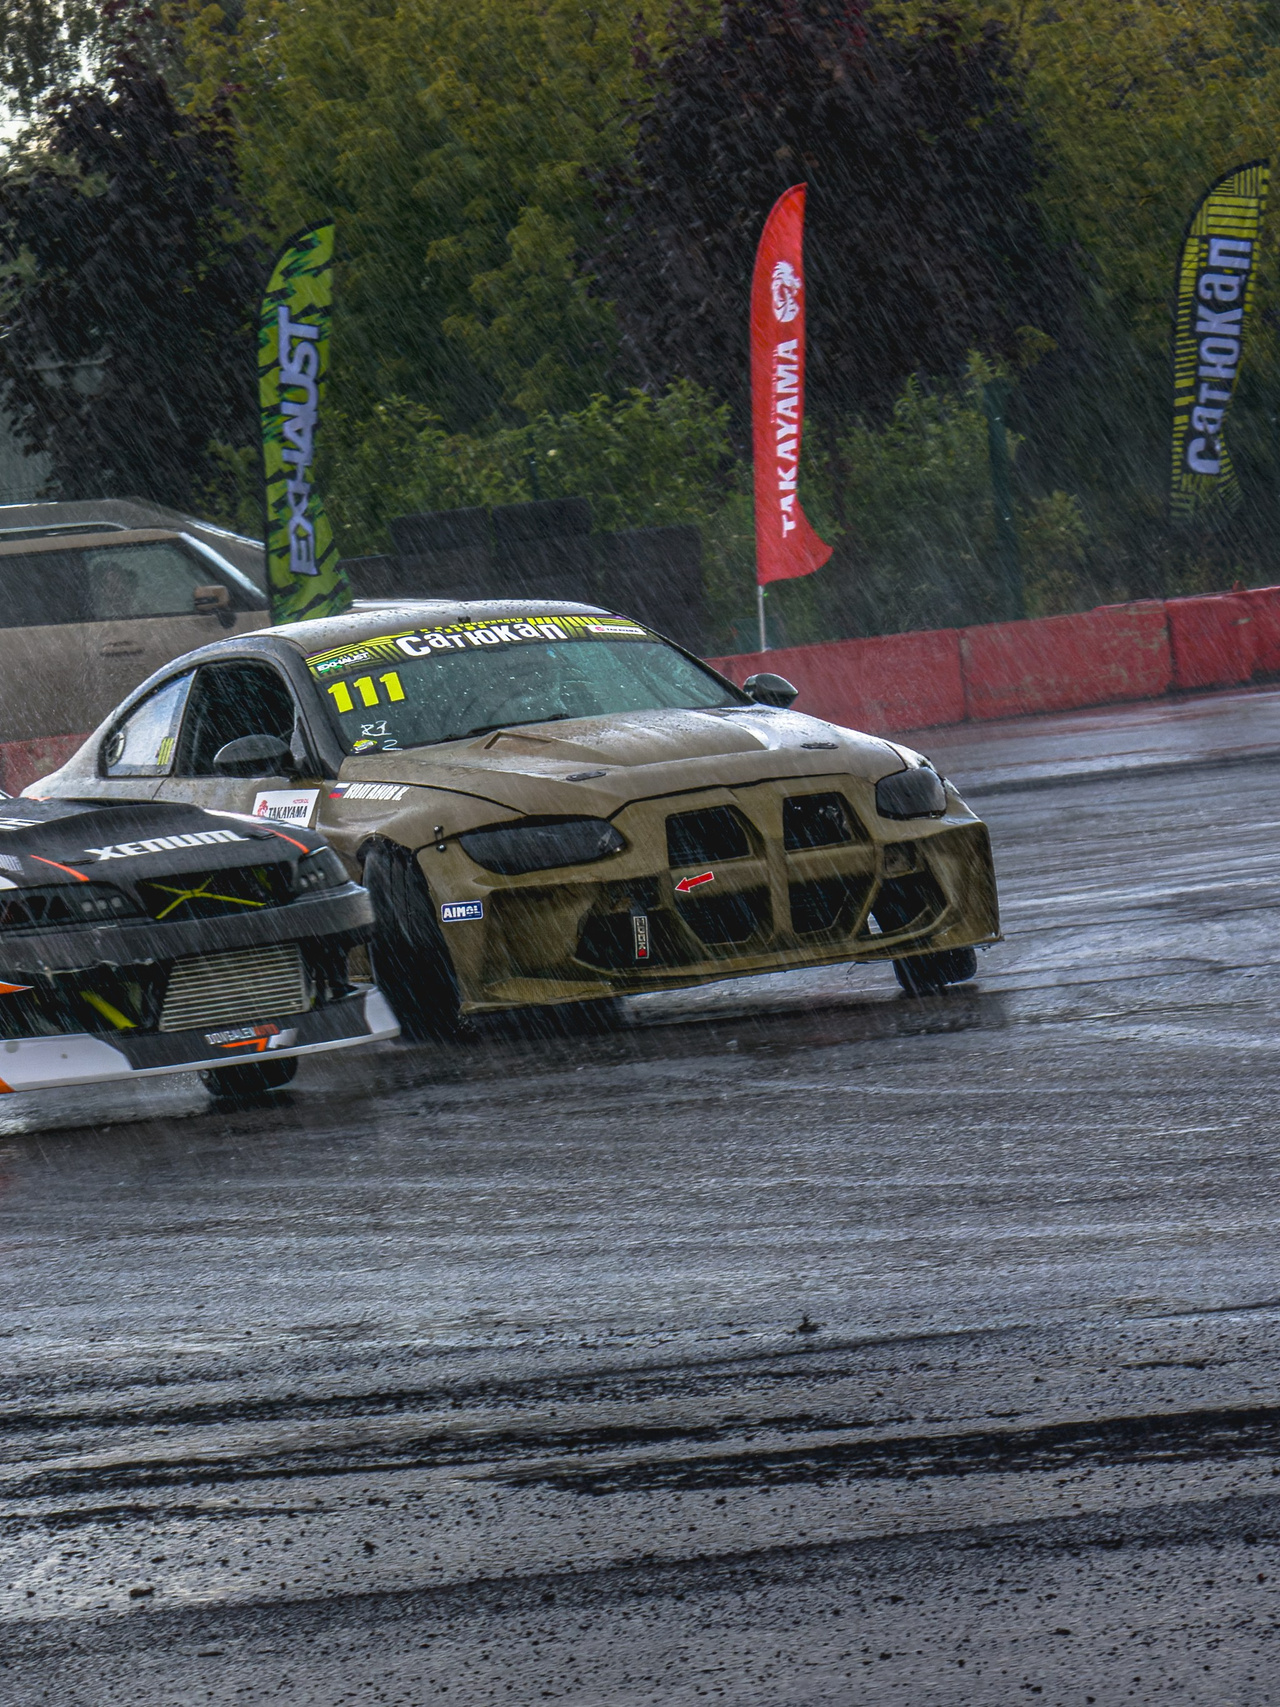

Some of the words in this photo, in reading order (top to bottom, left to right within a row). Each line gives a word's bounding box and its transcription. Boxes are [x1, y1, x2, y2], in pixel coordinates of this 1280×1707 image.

[278, 306, 320, 576] EXHAUST
[776, 338, 799, 538] TAKAYAMA
[327, 672, 405, 713] 111
[269, 805, 308, 819] TAKAYAMA
[84, 829, 250, 861] XENUM
[443, 905, 481, 919] AIMOL
